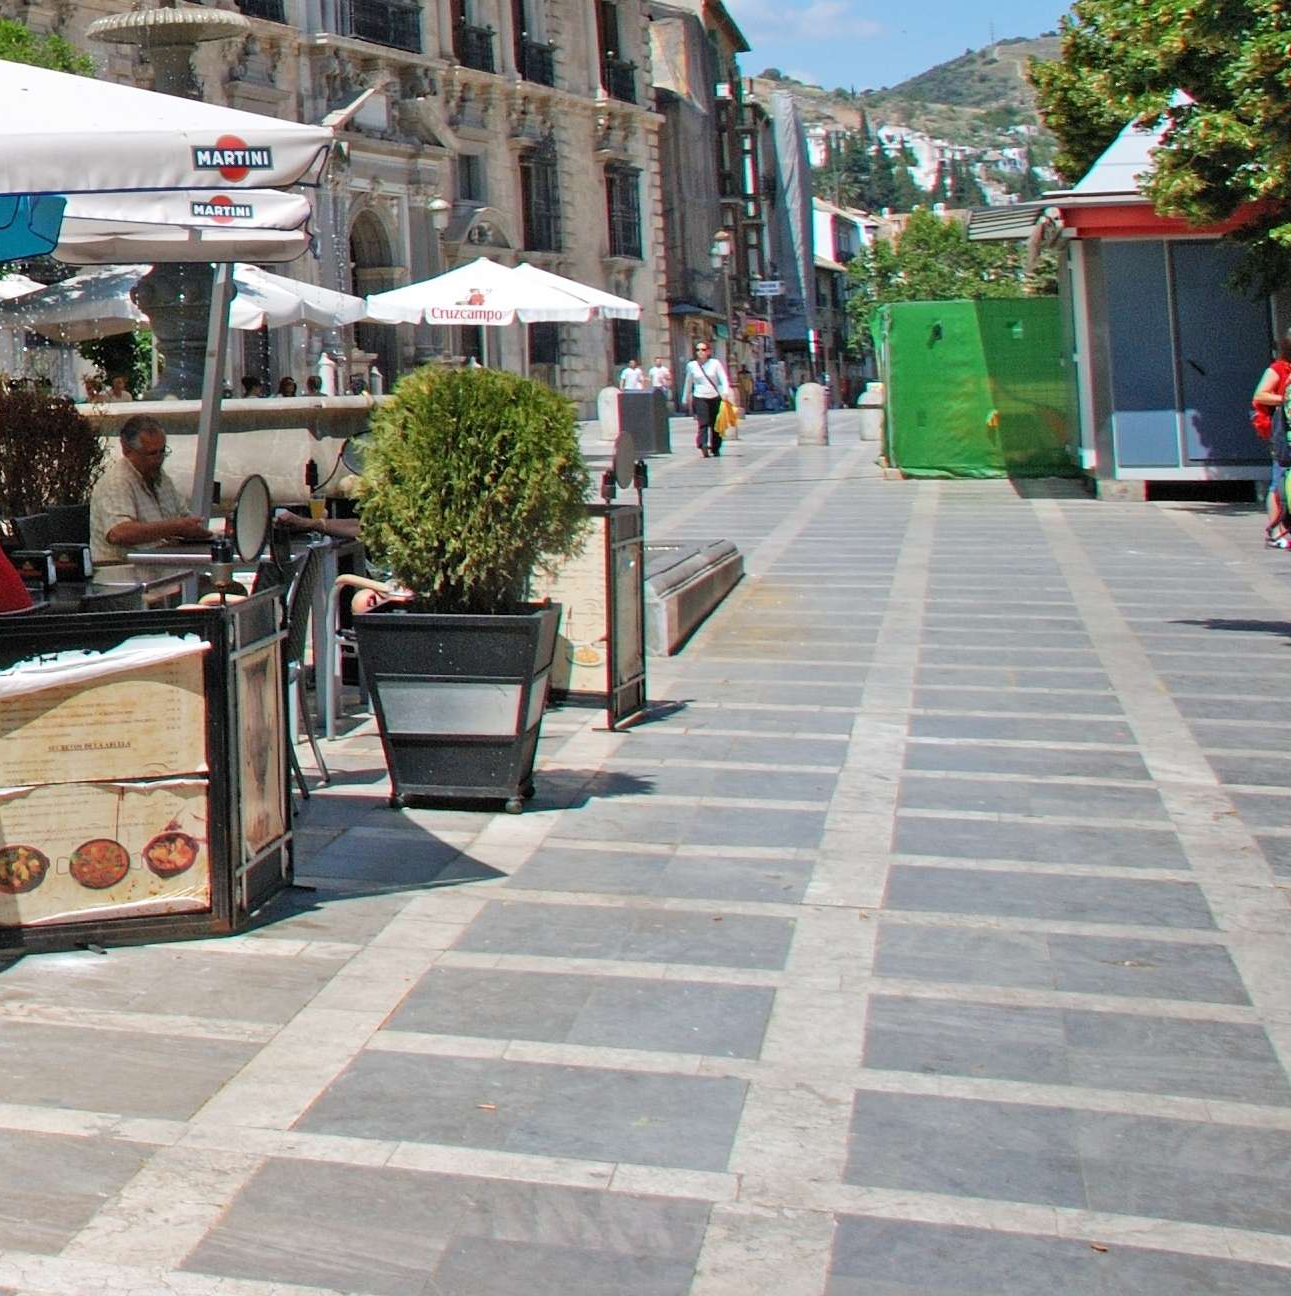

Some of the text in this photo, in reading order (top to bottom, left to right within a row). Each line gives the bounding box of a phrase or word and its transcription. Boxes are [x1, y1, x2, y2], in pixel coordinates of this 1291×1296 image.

[196, 149, 269, 167] MARTINI
[193, 203, 251, 218] MARTINI
[431, 307, 503, 322] Cruzcampo
